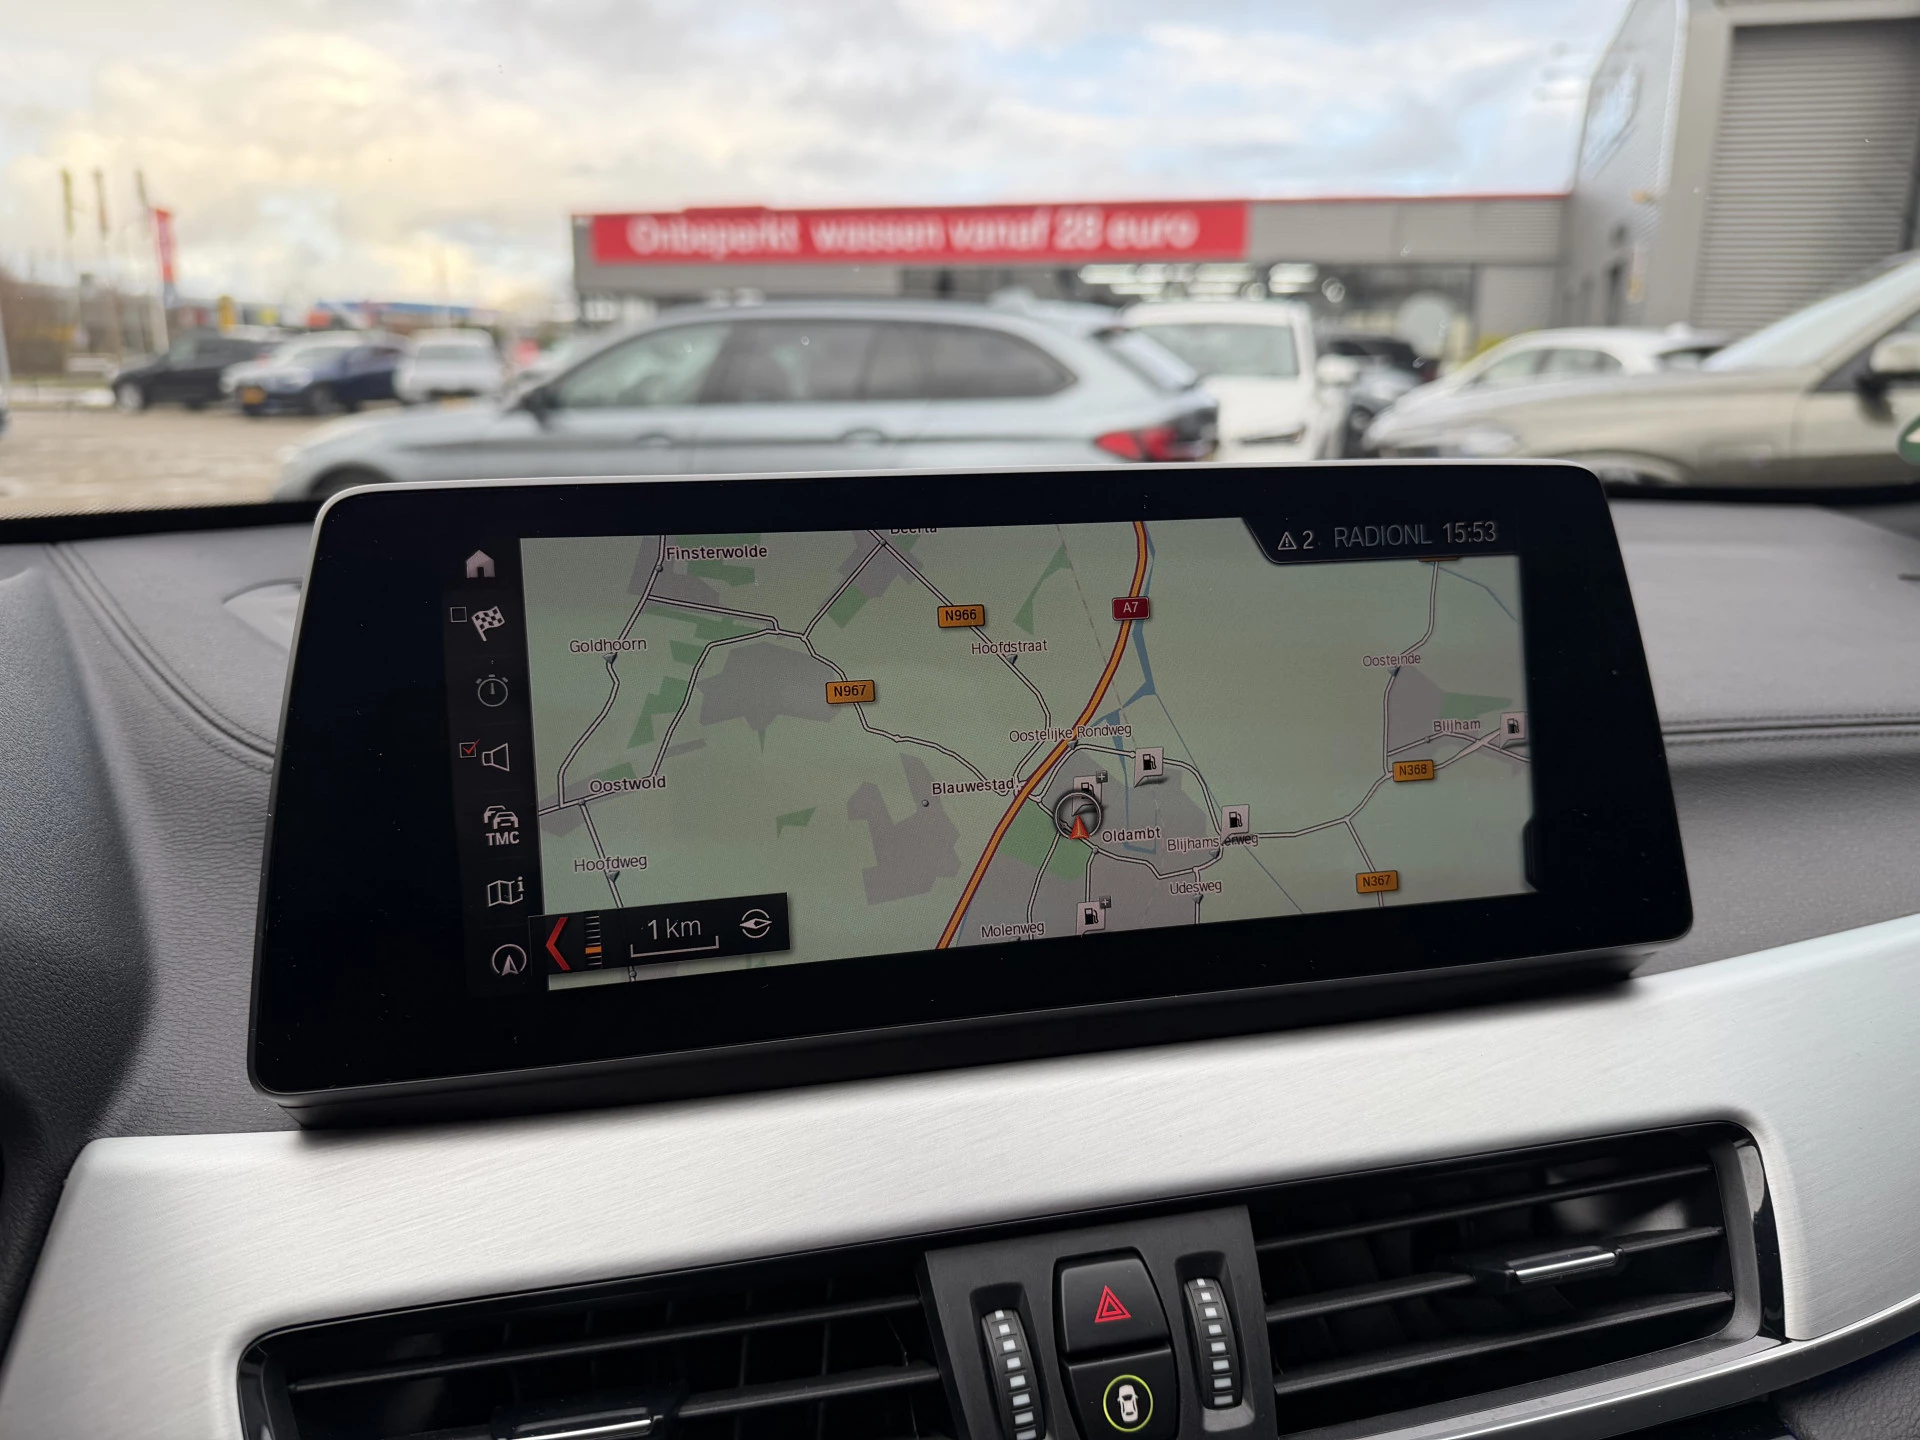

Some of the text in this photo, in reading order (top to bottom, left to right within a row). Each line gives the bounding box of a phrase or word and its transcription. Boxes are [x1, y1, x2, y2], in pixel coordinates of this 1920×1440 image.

[1106, 207, 1200, 249] euro
[1302, 531, 1314, 550] 2
[1333, 524, 1433, 549] RADIONL
[1442, 521, 1497, 544] 15:53
[665, 544, 768, 561] Finsterwolde
[945, 608, 977, 622] N966
[1123, 600, 1139, 615] A7
[569, 638, 648, 654] Goldhoorn
[970, 638, 1048, 656] Hoofdstraat
[1362, 652, 1422, 669] Oosteinde
[833, 683, 867, 698] N967
[1009, 723, 1133, 744] Oostelijke Rondweg
[1433, 718, 1482, 736] Blijham
[1399, 763, 1427, 776] N368
[589, 775, 667, 794] Oostwold
[931, 779, 1015, 796] Blauwestad
[485, 832, 520, 846] TMC
[1101, 826, 1162, 843] Oldambt
[573, 855, 649, 873] Hoofdweg
[1169, 879, 1223, 897] Udesweg
[1362, 875, 1391, 887] N367
[646, 918, 702, 940] 1 km
[980, 921, 1046, 941] Molenweg
